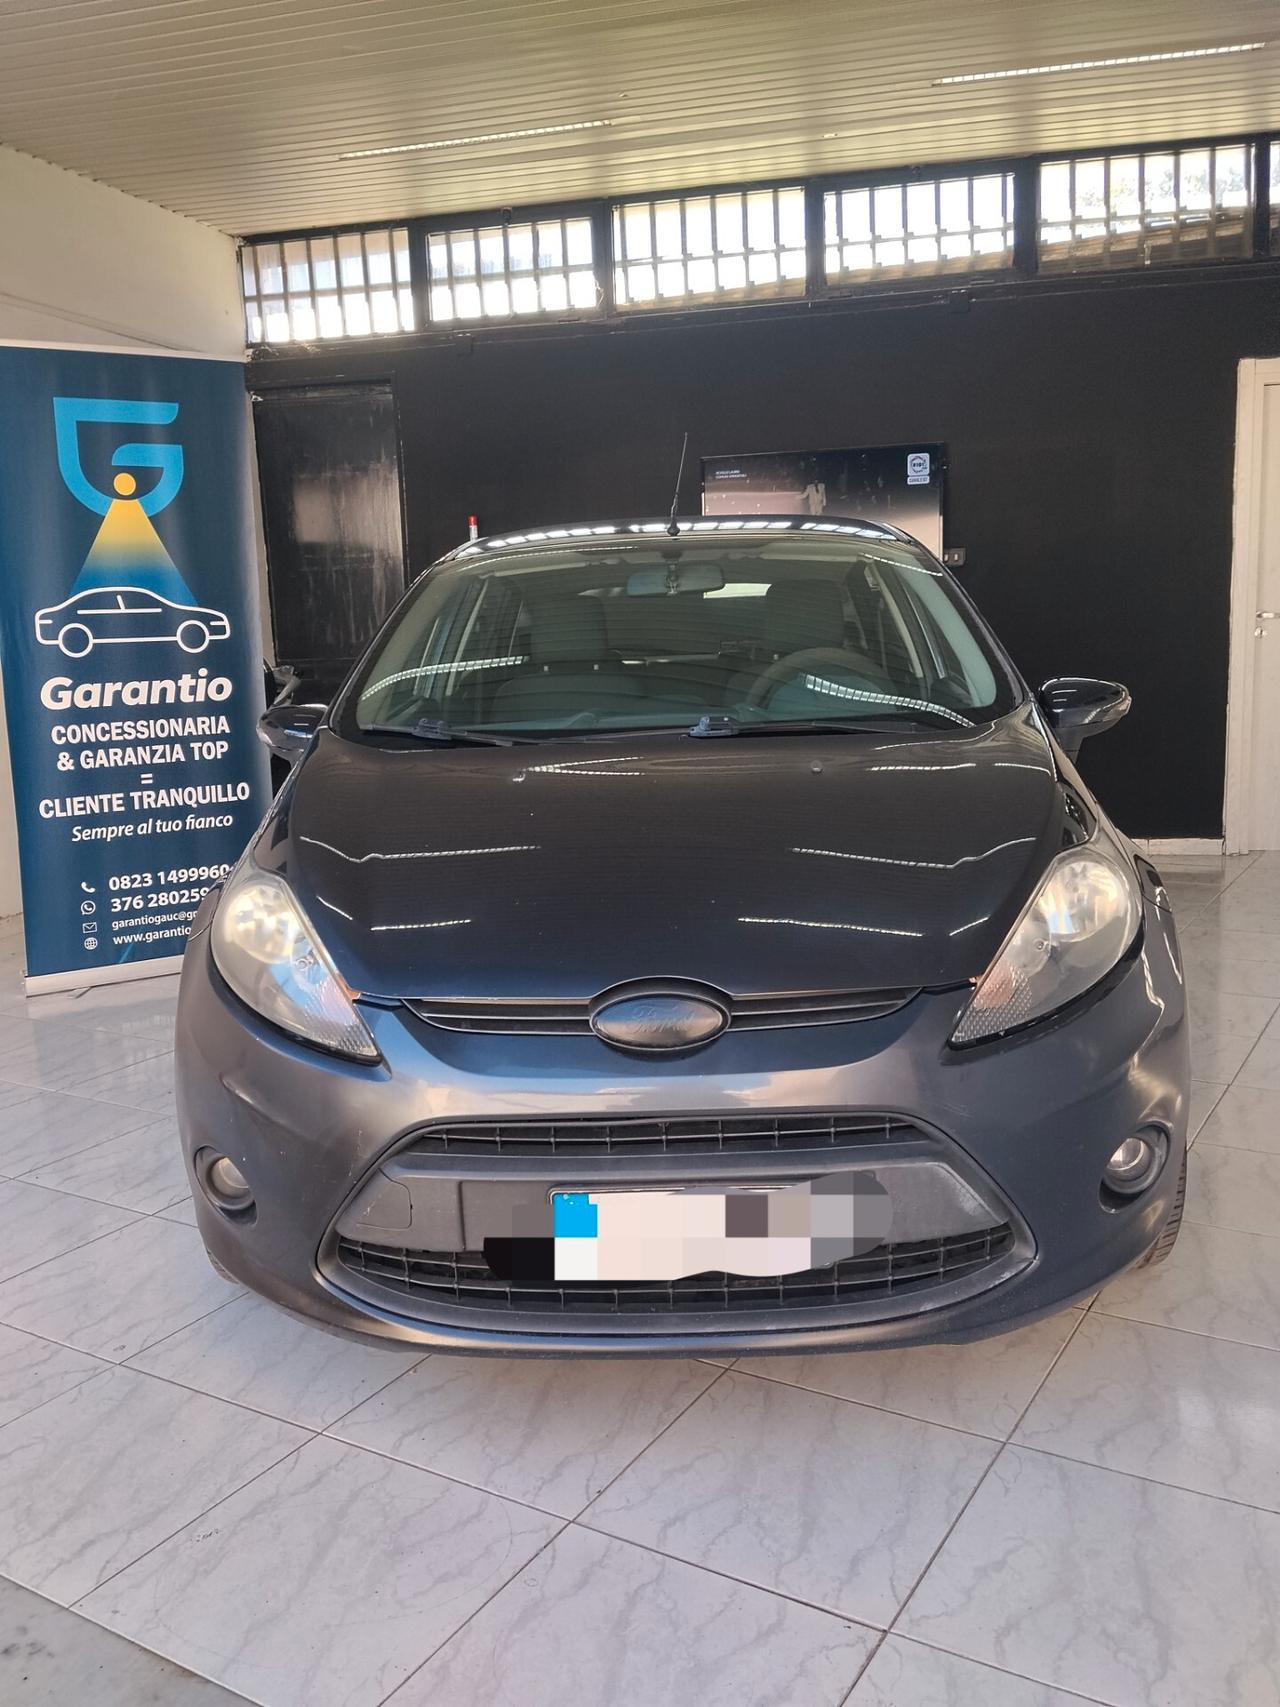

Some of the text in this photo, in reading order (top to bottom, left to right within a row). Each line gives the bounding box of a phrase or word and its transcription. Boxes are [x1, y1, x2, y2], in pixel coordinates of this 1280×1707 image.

[40, 668, 233, 710] Garantio
[51, 716, 230, 745] CONCESSIONARIA
[56, 741, 229, 771] & GARANZIA TOP
[39, 782, 250, 818] CLIENTE TRANQUILLO
[71, 814, 233, 842] Sempre al tuo fianco
[108, 864, 230, 891] 0823 1499960
[111, 897, 144, 912] 376
